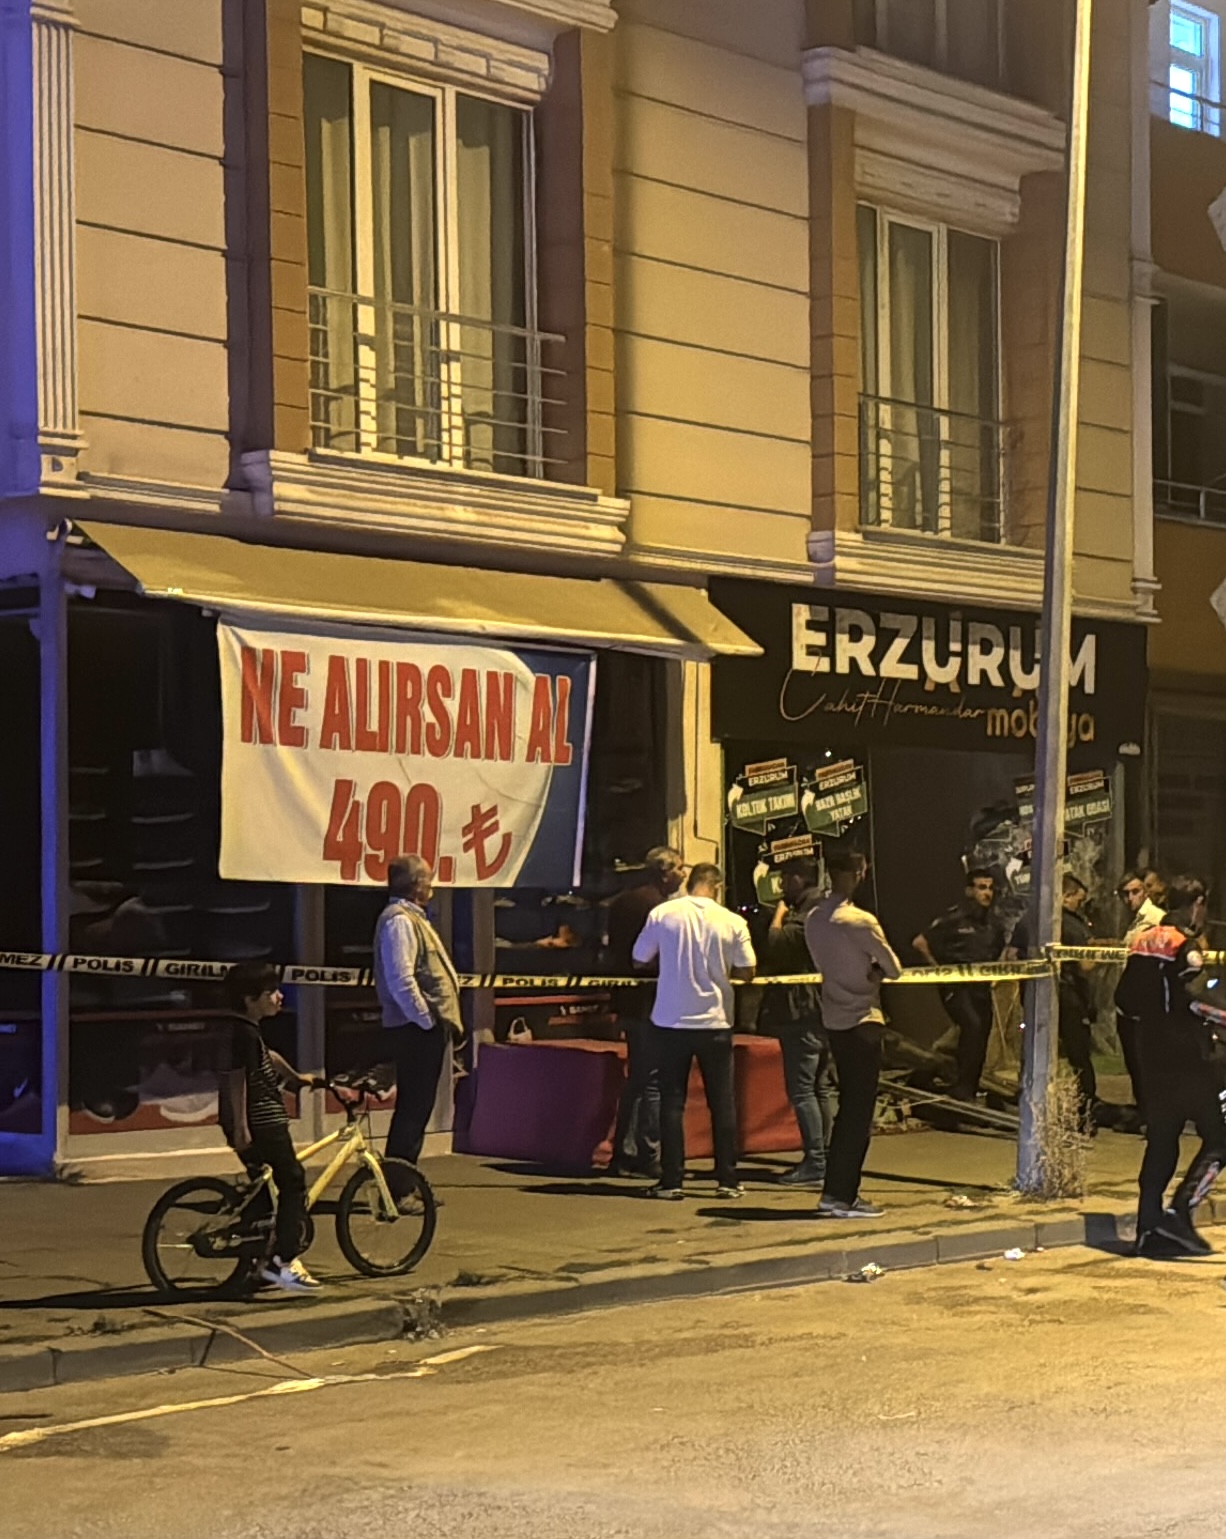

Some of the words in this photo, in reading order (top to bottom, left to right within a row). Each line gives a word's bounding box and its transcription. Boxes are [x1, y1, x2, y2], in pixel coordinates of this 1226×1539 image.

[241, 646, 308, 748] NE
[319, 655, 516, 762] ALIRSAN
[526, 673, 574, 765] AL
[986, 700, 1095, 749] mobya
[749, 770, 788, 787] ERZURUM
[819, 771, 857, 791] ERZURUM
[1064, 804, 1085, 821] ATAK
